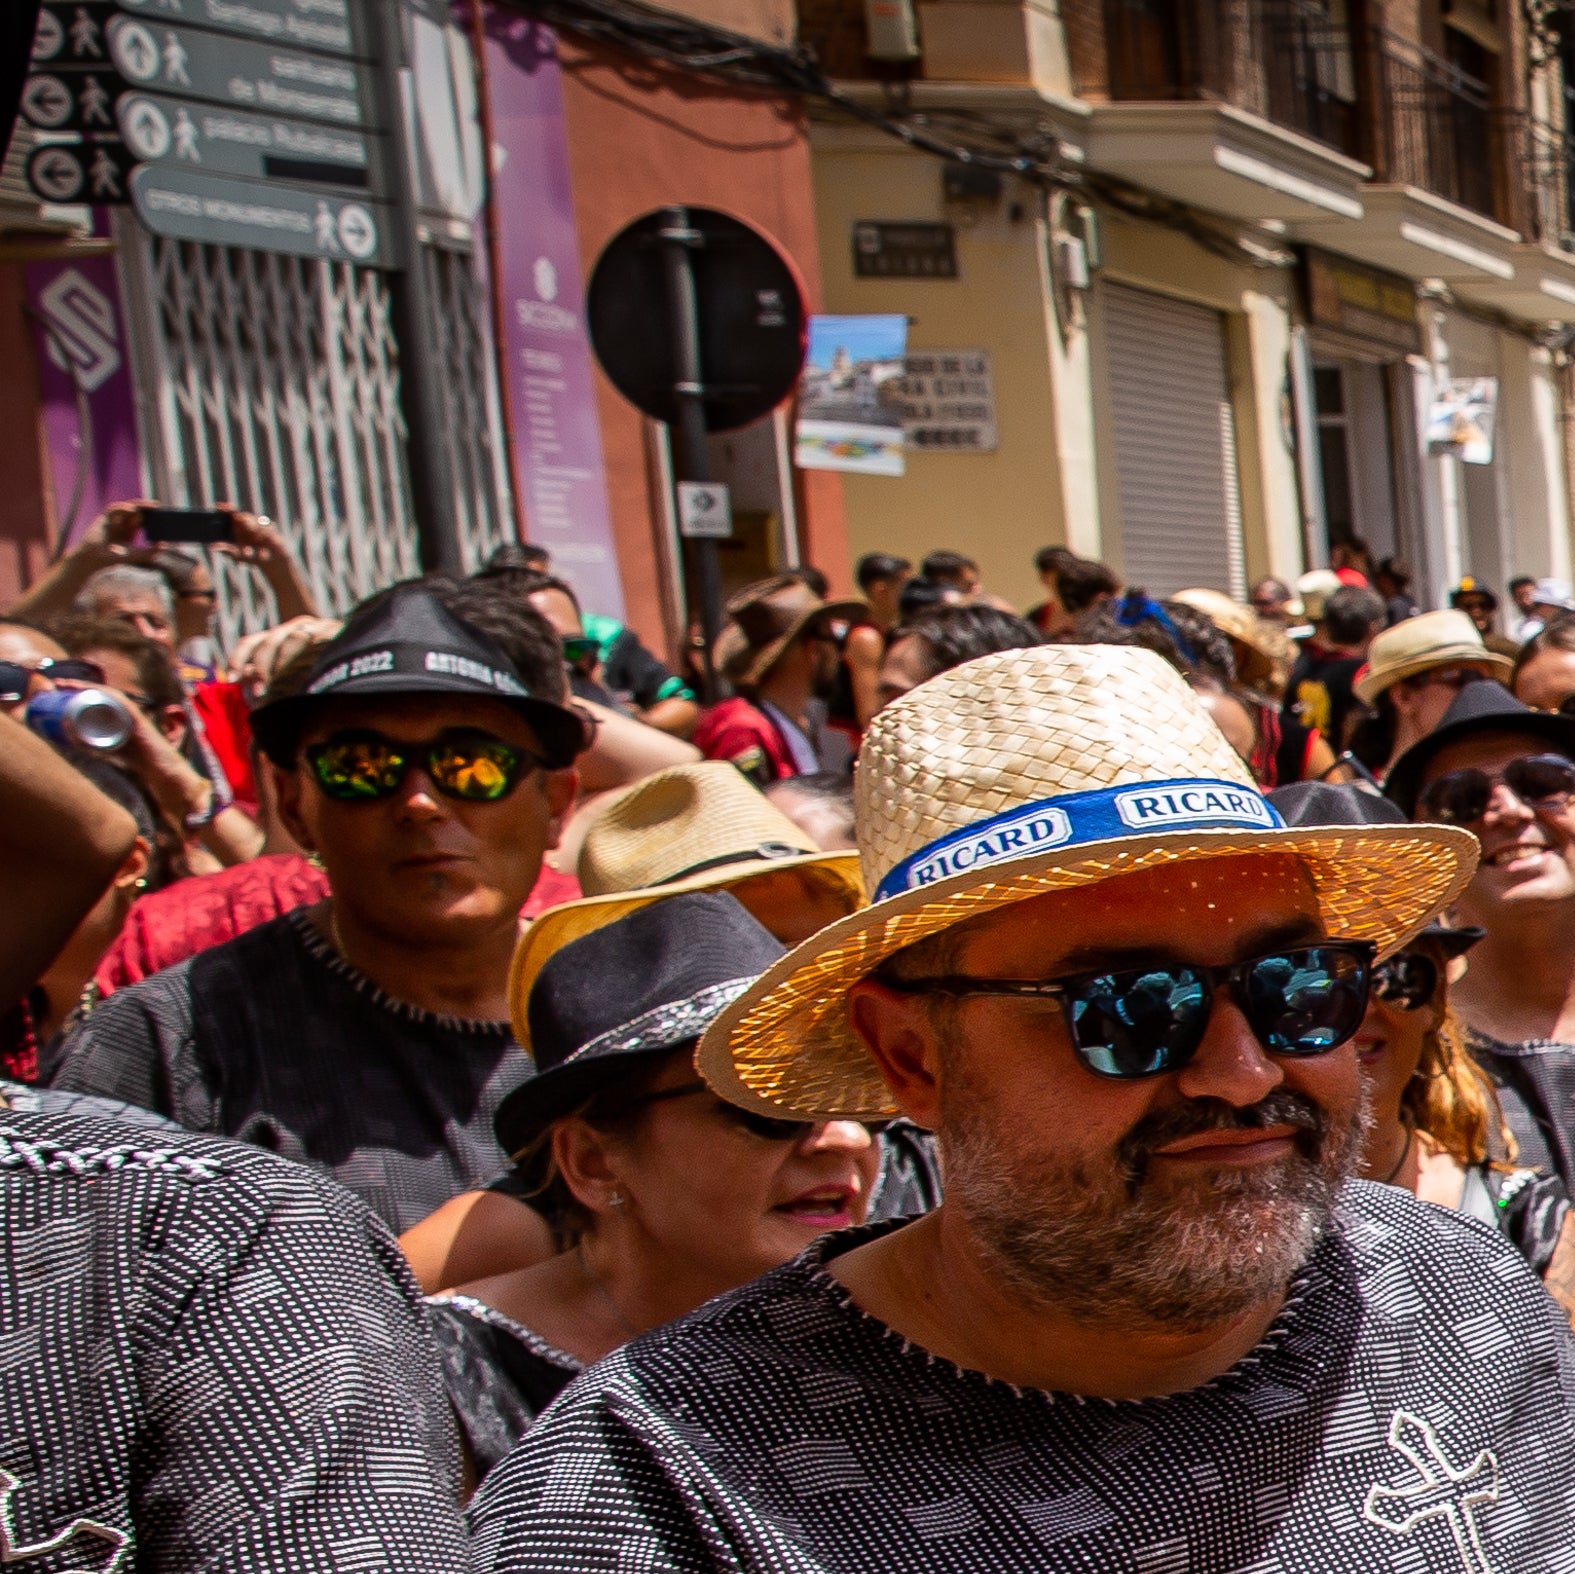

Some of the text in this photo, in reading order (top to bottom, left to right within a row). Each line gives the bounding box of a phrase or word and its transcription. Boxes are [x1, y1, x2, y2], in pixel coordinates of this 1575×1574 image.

[350, 650, 395, 677] 2022
[1131, 790, 1264, 819] RICARD
[918, 815, 1057, 888] RICARD
